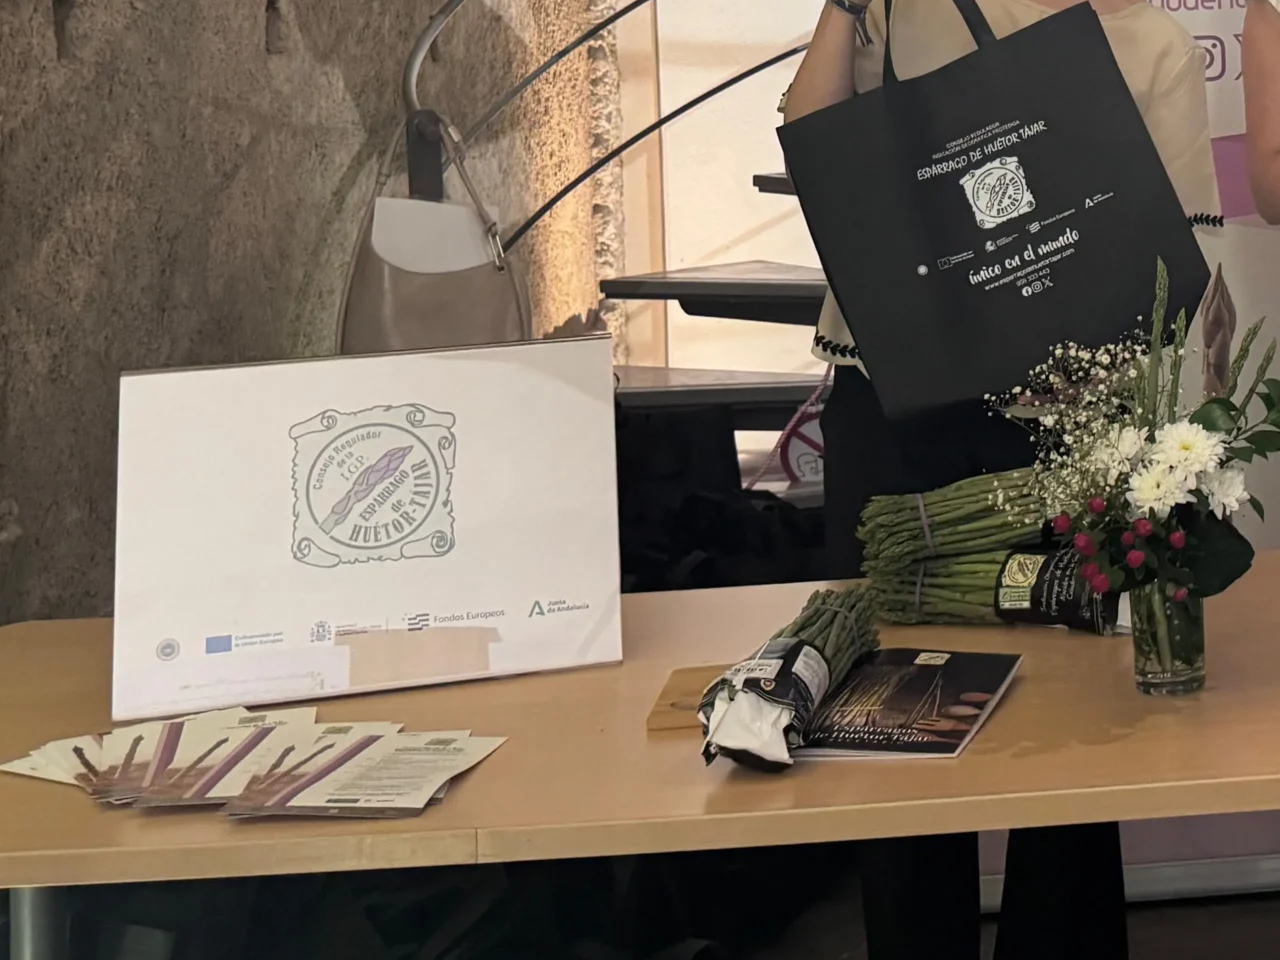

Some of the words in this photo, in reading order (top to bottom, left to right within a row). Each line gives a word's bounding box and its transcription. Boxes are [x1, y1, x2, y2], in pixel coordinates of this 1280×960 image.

[968, 148, 984, 163] DE
[1004, 254, 1021, 270] en
[1023, 243, 1036, 261] el
[1037, 227, 1080, 256] mundo
[313, 454, 335, 490] Consejo
[333, 430, 383, 455] Regulador
[336, 457, 347, 469] de
[346, 451, 355, 460] la
[391, 498, 406, 514] de
[547, 599, 567, 607] Junta
[434, 613, 465, 624] Fondos
[466, 609, 505, 621] Europeos
